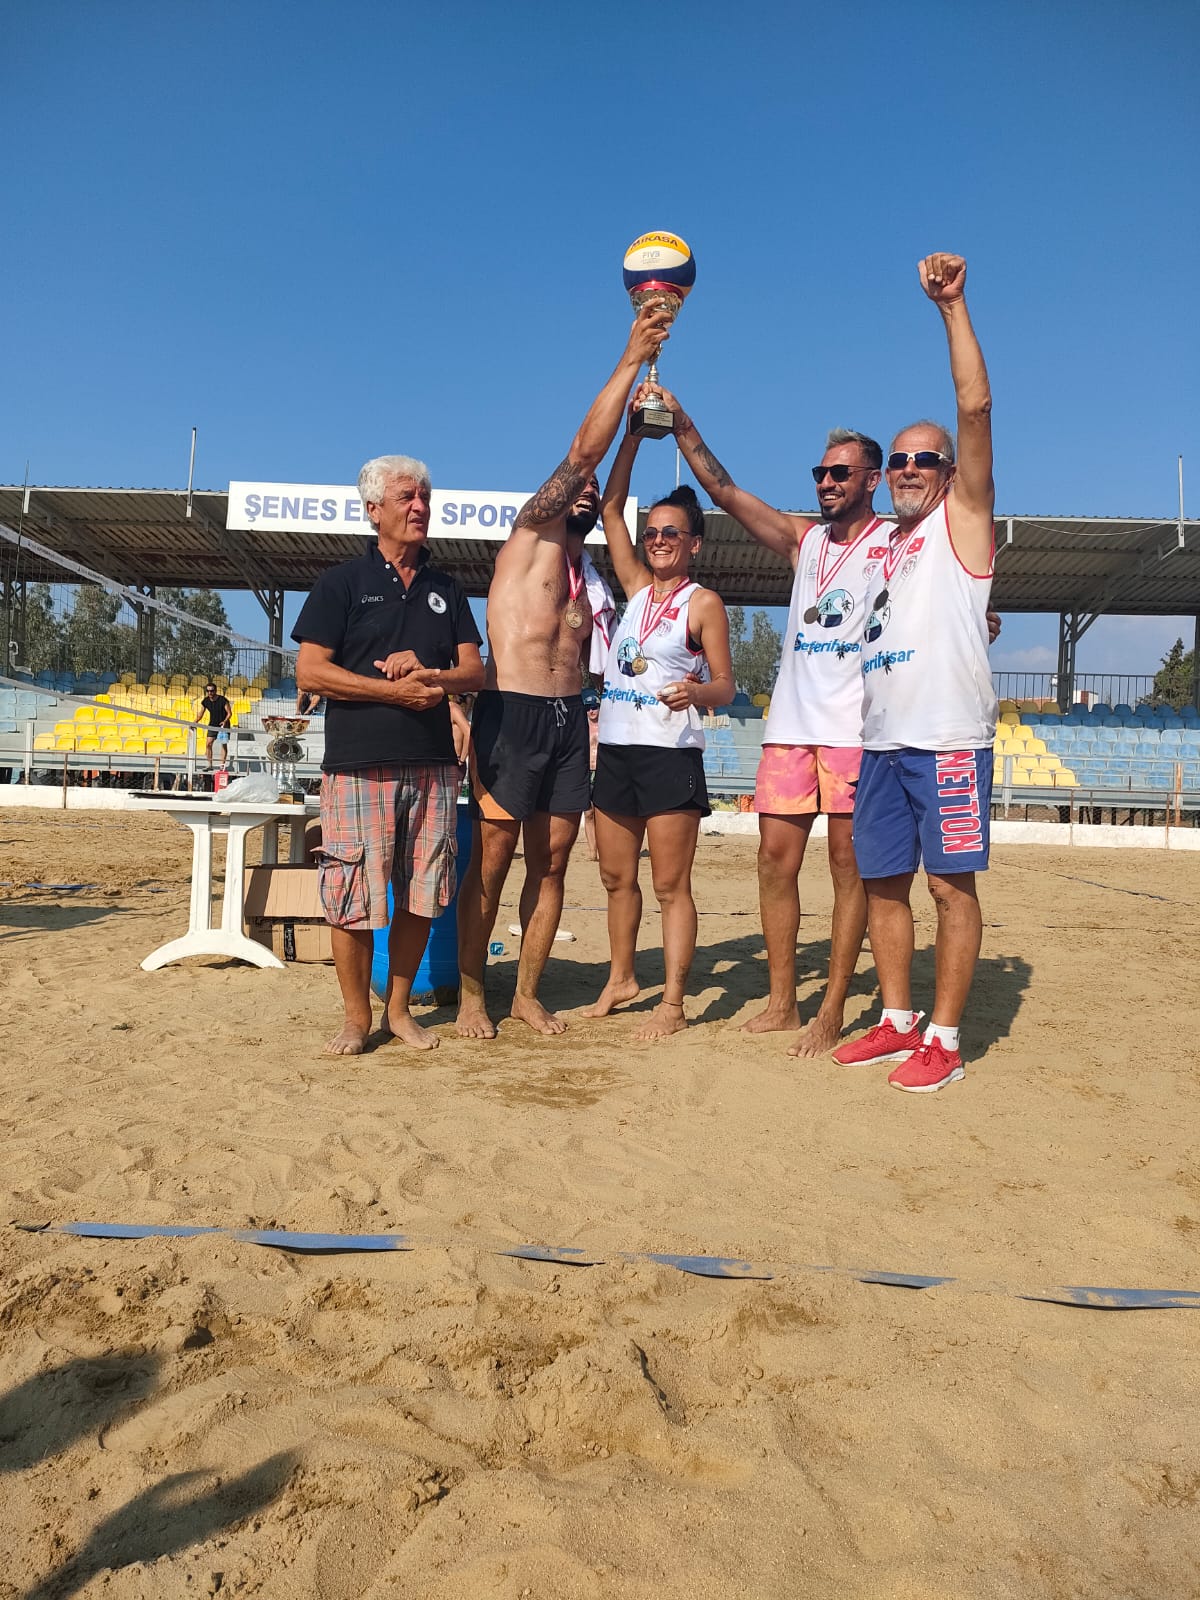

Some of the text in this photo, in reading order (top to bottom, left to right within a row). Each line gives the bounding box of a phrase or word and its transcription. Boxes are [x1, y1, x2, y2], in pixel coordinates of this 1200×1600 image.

[630, 235, 678, 250] MIKASA
[244, 494, 337, 522] ŞENES
[441, 502, 518, 527] SPOR
[935, 750, 983, 854] NETTON
